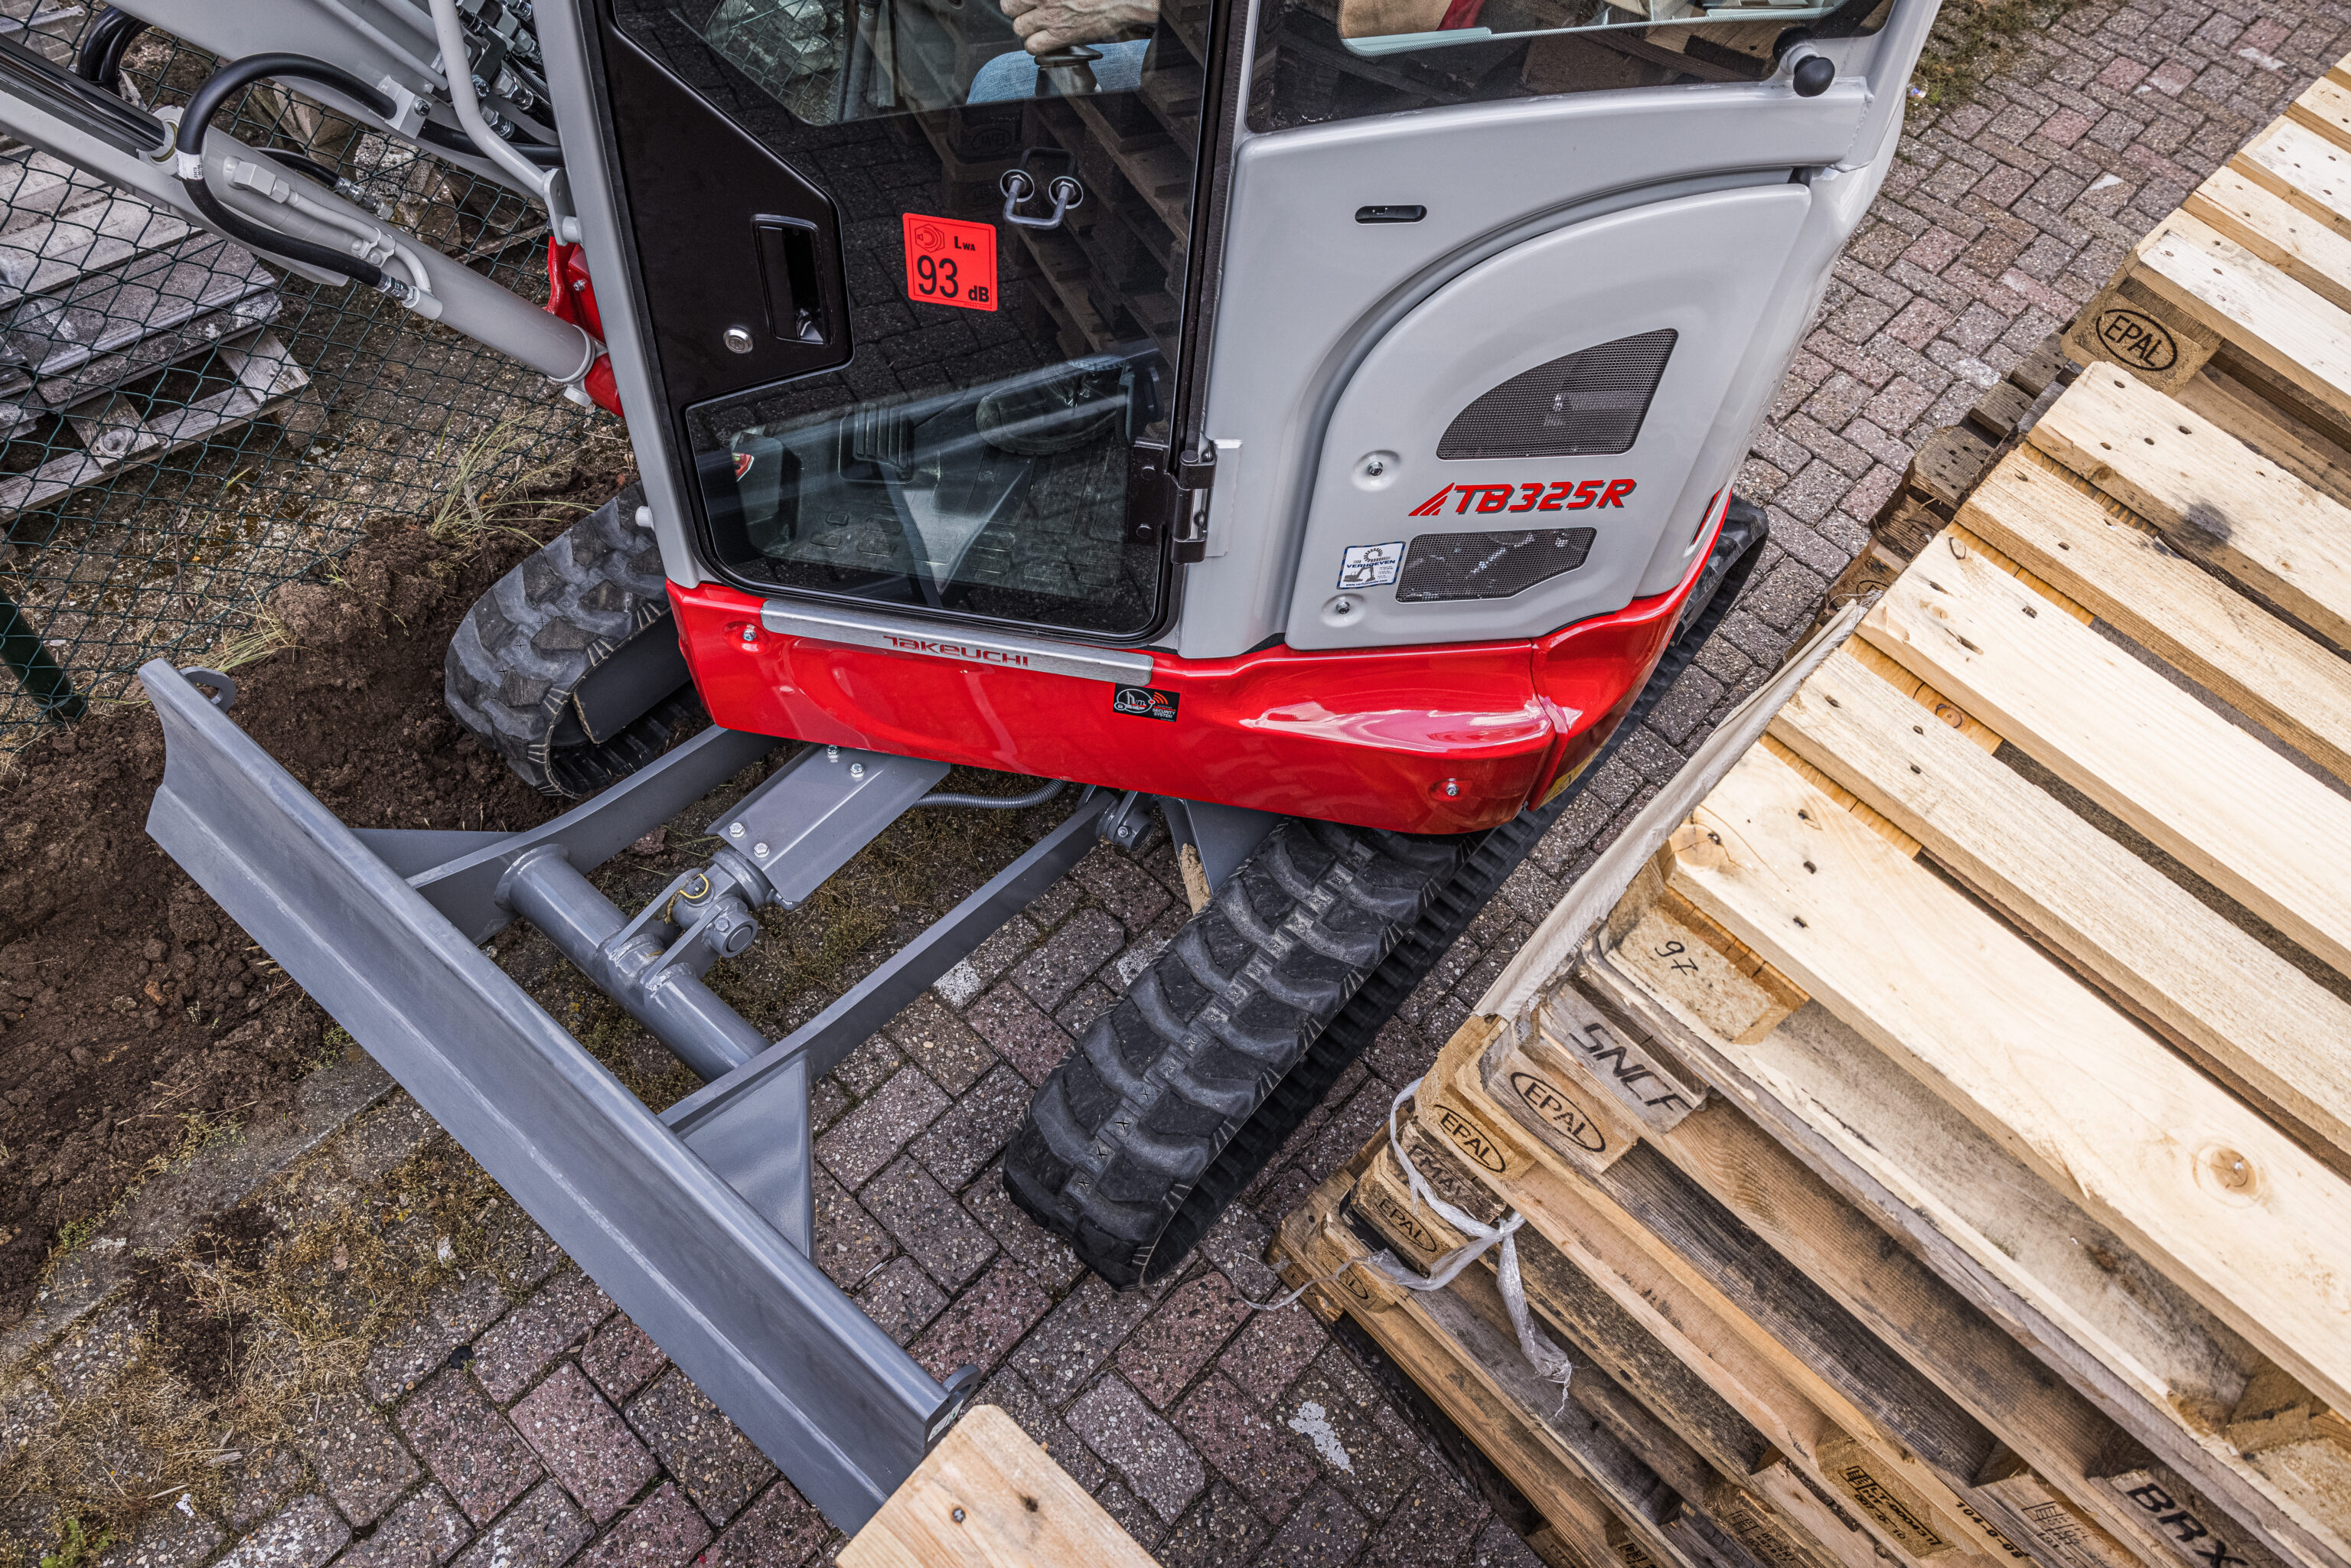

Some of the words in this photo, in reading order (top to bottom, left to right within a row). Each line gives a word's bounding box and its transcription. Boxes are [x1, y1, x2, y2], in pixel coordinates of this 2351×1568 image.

[917, 255, 959, 298] 93
[968, 285, 990, 302] dB
[2104, 315, 2162, 367] EPAL
[1454, 478, 1637, 515] TB325R
[1346, 559, 1396, 569] VERHOEVEN
[1655, 940, 1698, 976] 97
[1569, 1022, 1694, 1111] SNCF
[1524, 1081, 1587, 1146] EPAL
[1440, 1112, 1490, 1165] EPAL
[1379, 1198, 1423, 1246] EPAL
[1862, 1489, 1883, 1505] HT
